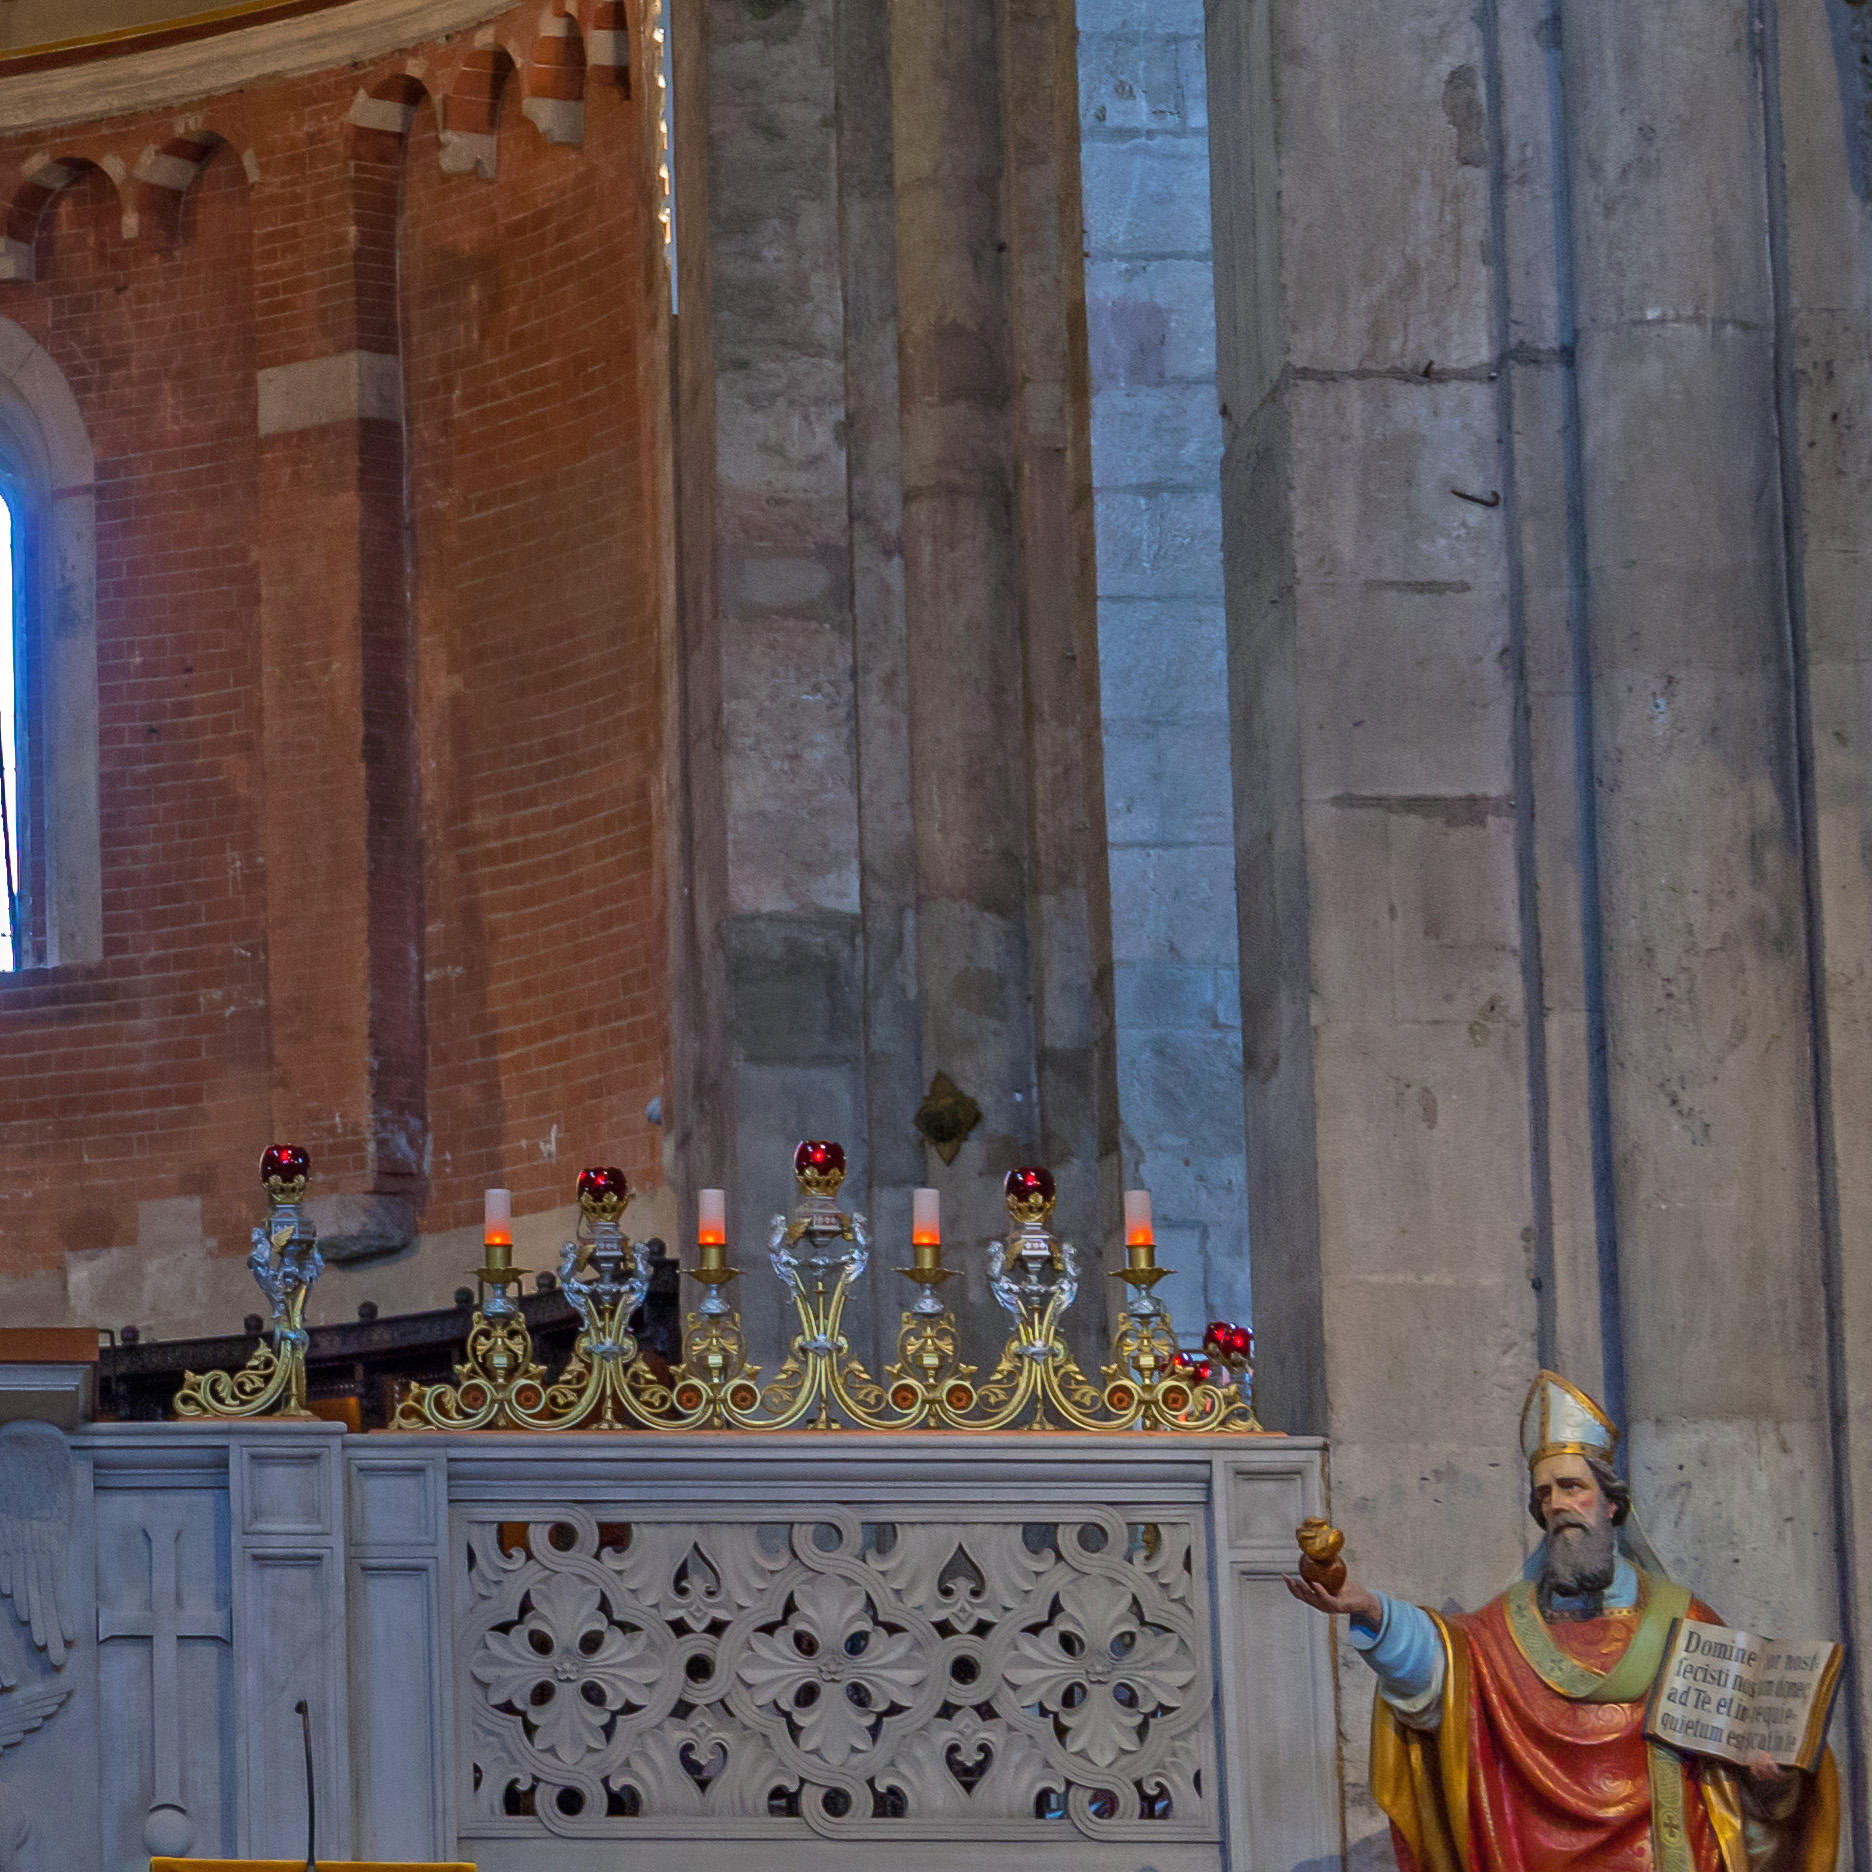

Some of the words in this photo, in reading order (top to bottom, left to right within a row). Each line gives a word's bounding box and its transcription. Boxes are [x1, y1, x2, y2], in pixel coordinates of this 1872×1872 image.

[1684, 1630, 1757, 1667] Domine
[1674, 1657, 1727, 1686] fecisti
[1667, 1685, 1689, 1707] ad
[1661, 1712, 1723, 1743] quietum
